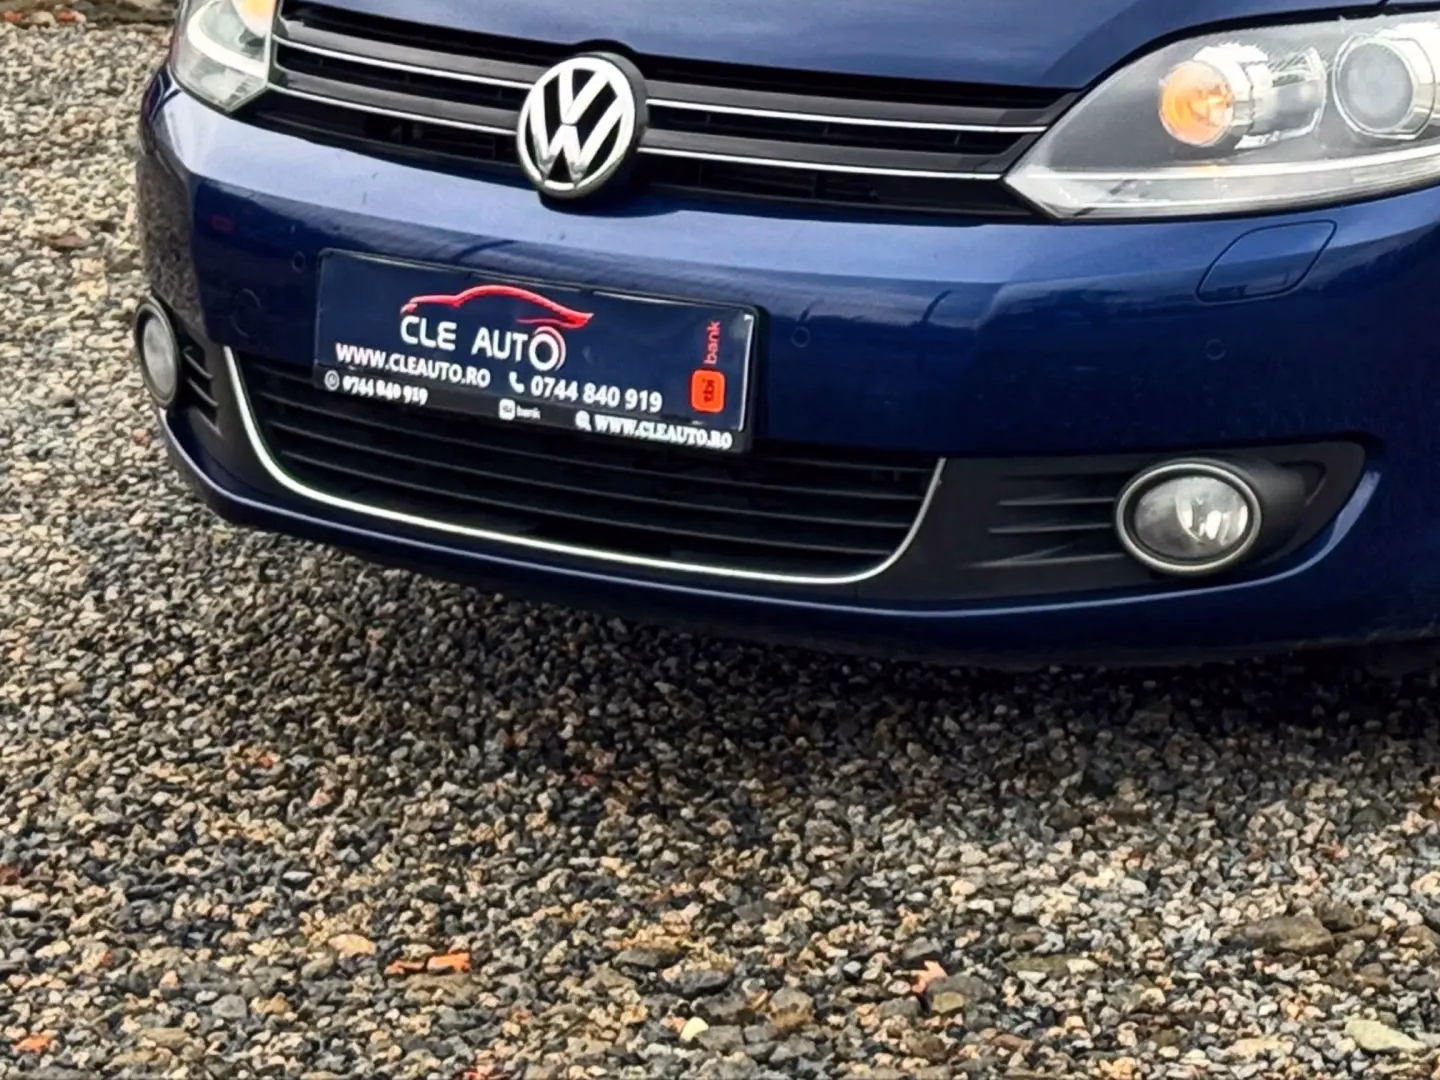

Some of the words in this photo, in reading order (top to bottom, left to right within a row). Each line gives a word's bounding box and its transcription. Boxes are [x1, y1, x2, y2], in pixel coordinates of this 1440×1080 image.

[335, 342, 491, 388] WWW.CLEAUTO.RO
[401, 315, 457, 351] CLE
[471, 324, 566, 371] AUTO
[529, 375, 578, 402] 0744
[582, 385, 621, 408] 840
[625, 388, 663, 414] 919
